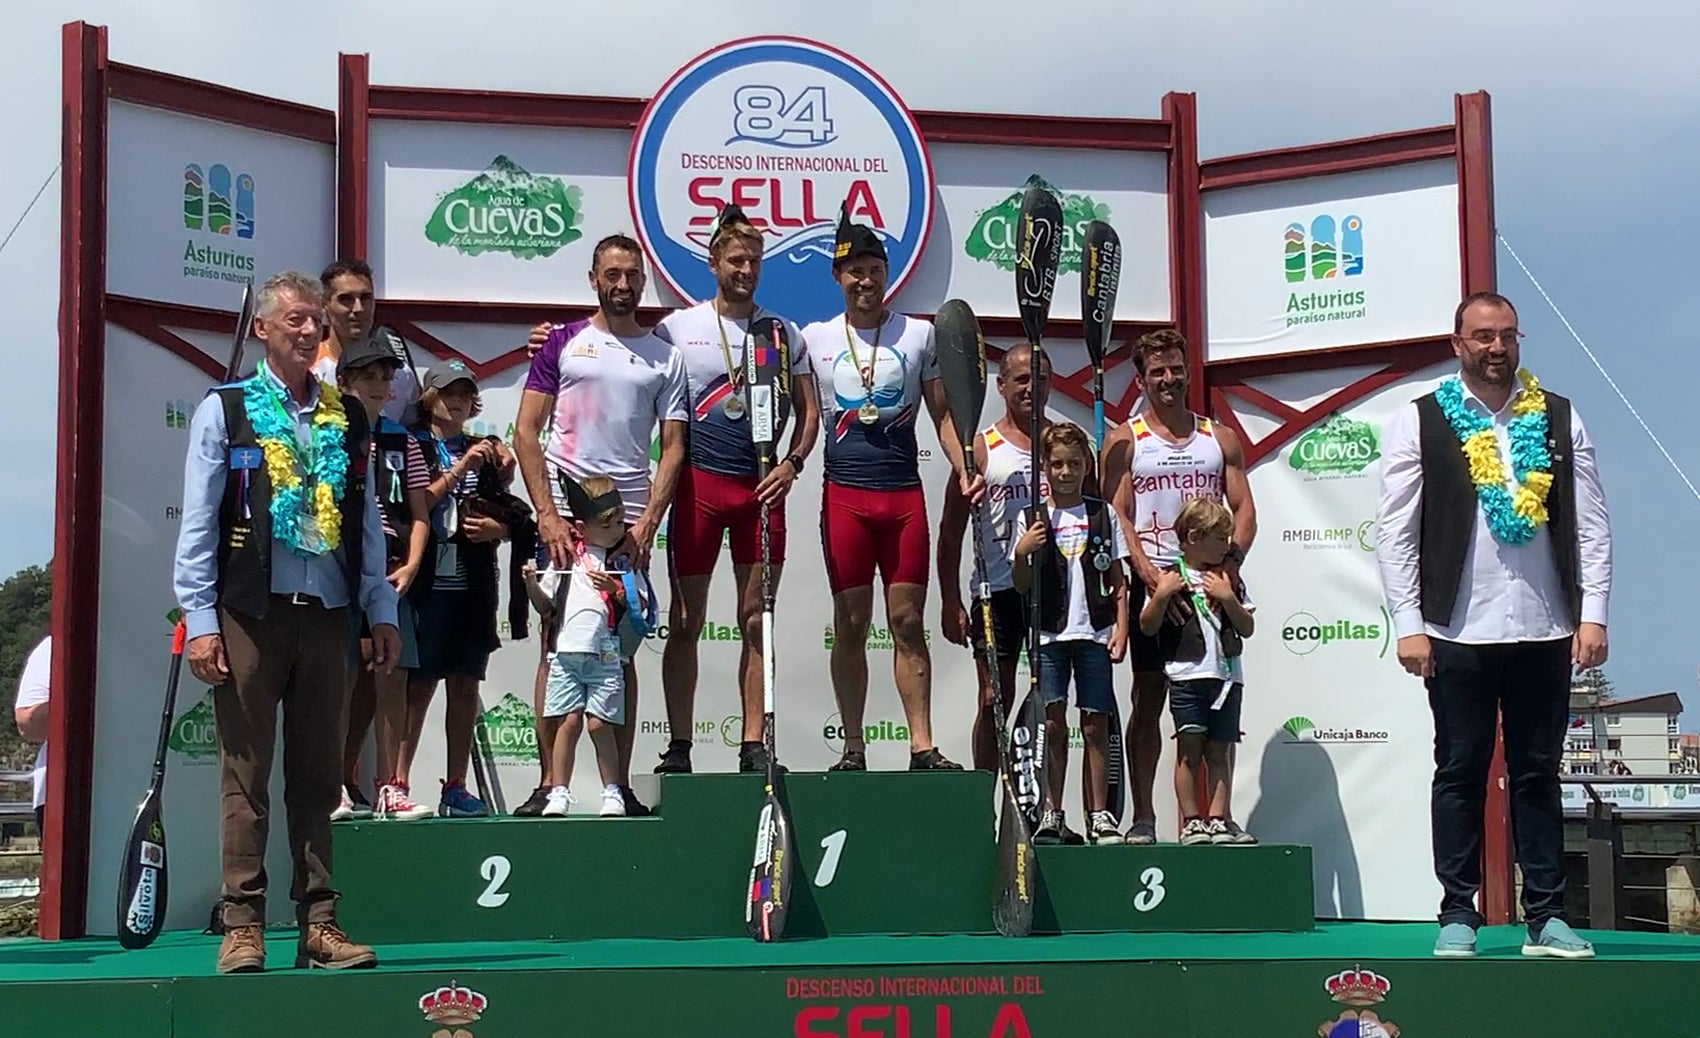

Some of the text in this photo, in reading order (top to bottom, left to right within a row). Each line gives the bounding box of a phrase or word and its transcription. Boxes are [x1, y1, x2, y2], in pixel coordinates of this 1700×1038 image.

[733, 84, 834, 142] 84
[681, 152, 889, 174] DESCENSO INTERNACIONAL DEL
[688, 176, 886, 229] SELLA
[183, 239, 255, 272] Asturias
[183, 265, 220, 280] paraíso
[1092, 240, 1115, 323] Cantabria
[1286, 289, 1366, 313] Asturias
[1286, 307, 1366, 328] paraíso natural
[1282, 528, 1354, 542] AMBILAMP
[1282, 620, 1381, 645] ecopilas
[641, 720, 716, 734] AMBMP
[823, 720, 909, 745] ecpila
[1313, 728, 1389, 741] Unicaja Banco
[1033, 722, 1046, 769] Aventura
[813, 828, 848, 888] 1
[476, 854, 512, 908] 2
[1132, 866, 1167, 913] 3
[138, 868, 153, 927] Silvota
[785, 976, 1045, 998] DESCENSO INTERNACIONAL DEL
